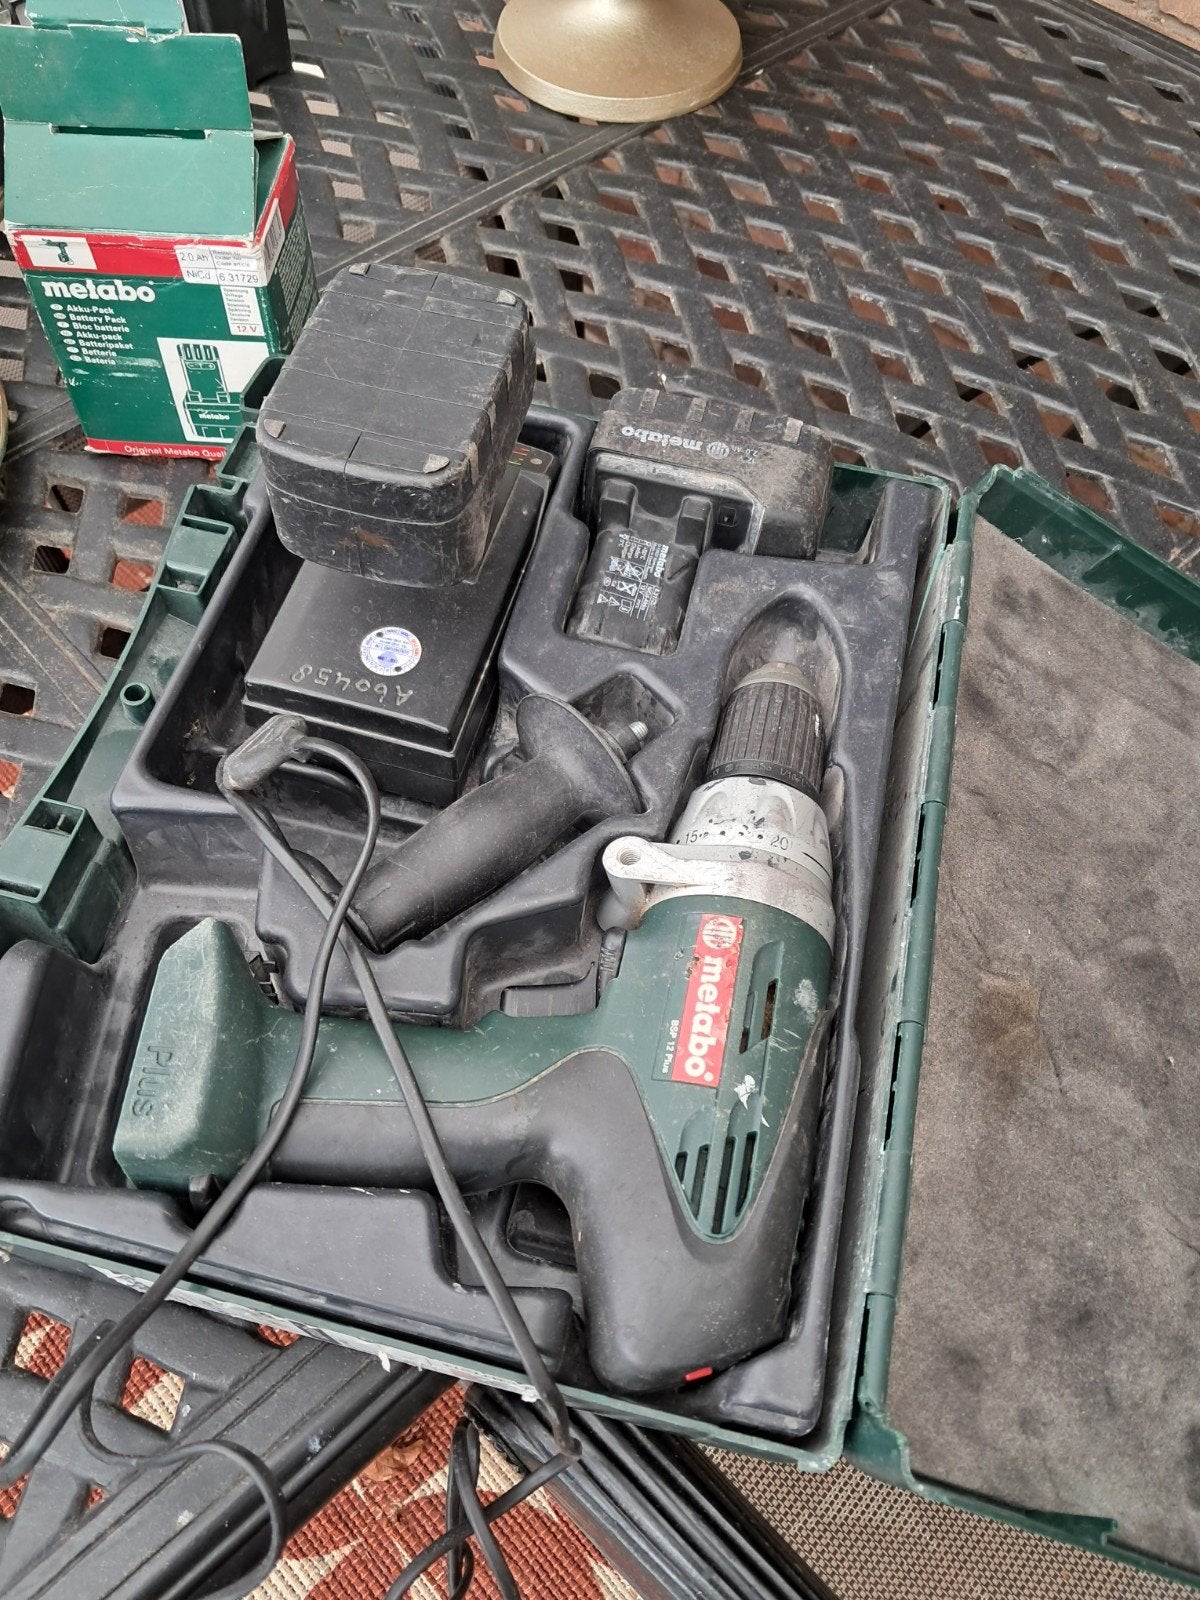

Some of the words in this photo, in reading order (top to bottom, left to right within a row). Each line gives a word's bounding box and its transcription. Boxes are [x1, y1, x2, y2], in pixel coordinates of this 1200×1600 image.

[196, 254, 209, 262] Ah
[186, 270, 211, 280] NiCd
[219, 273, 259, 284] 6.31729
[41, 279, 156, 303] metabo
[66, 304, 115, 314] Akku-Pack
[69, 313, 103, 323] Battery
[104, 315, 127, 324] Pack
[72, 322, 93, 331] Bloc
[94, 323, 130, 333] batterie
[236, 325, 247, 333] 12
[76, 331, 123, 341] Akku-pack
[78, 339, 134, 350] Batteripaket
[81, 347, 117, 357] Batteria
[198, 412, 230, 421] metabo
[621, 426, 703, 451] metabo
[124, 445, 162, 455] Original
[163, 447, 200, 458] Metabo
[653, 544, 670, 578] metabo
[685, 829, 699, 844] 15
[770, 835, 789, 851] 20
[684, 955, 724, 1078] metabo
[669, 1019, 680, 1039] BSP
[666, 1041, 675, 1052] 12
[662, 1053, 673, 1074] Plus
[132, 1045, 174, 1117] Plus
